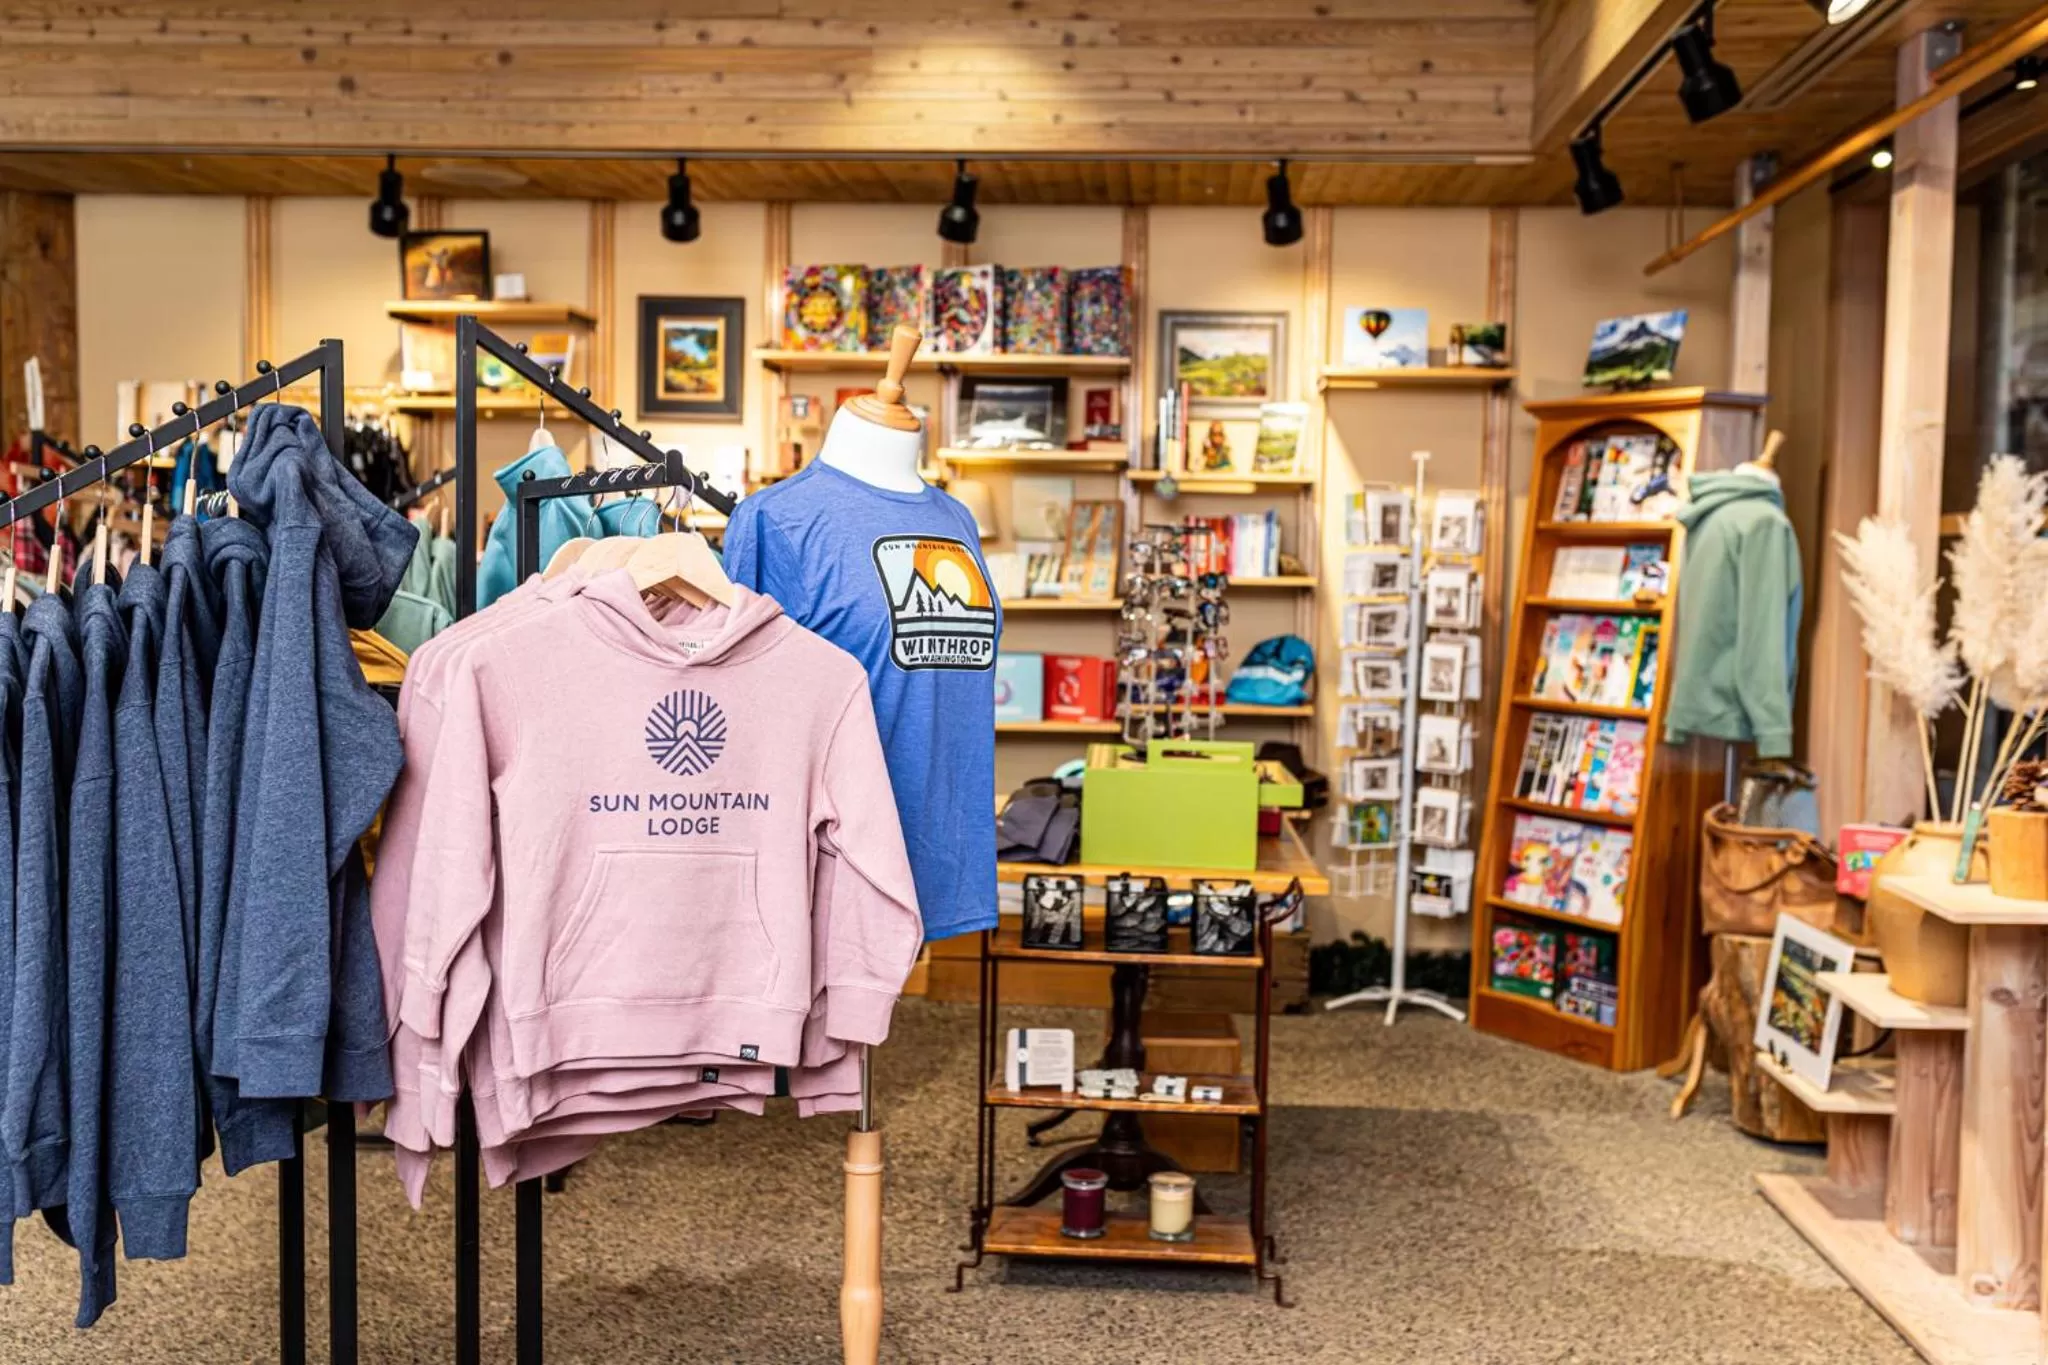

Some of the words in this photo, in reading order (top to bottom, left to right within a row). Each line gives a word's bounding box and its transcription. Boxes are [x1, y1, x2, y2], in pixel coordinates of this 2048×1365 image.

[901, 638, 991, 655] WINTHROP
[589, 795, 640, 812] SUN
[649, 793, 770, 811] MOUNTAIN
[648, 817, 720, 836] LODGE
